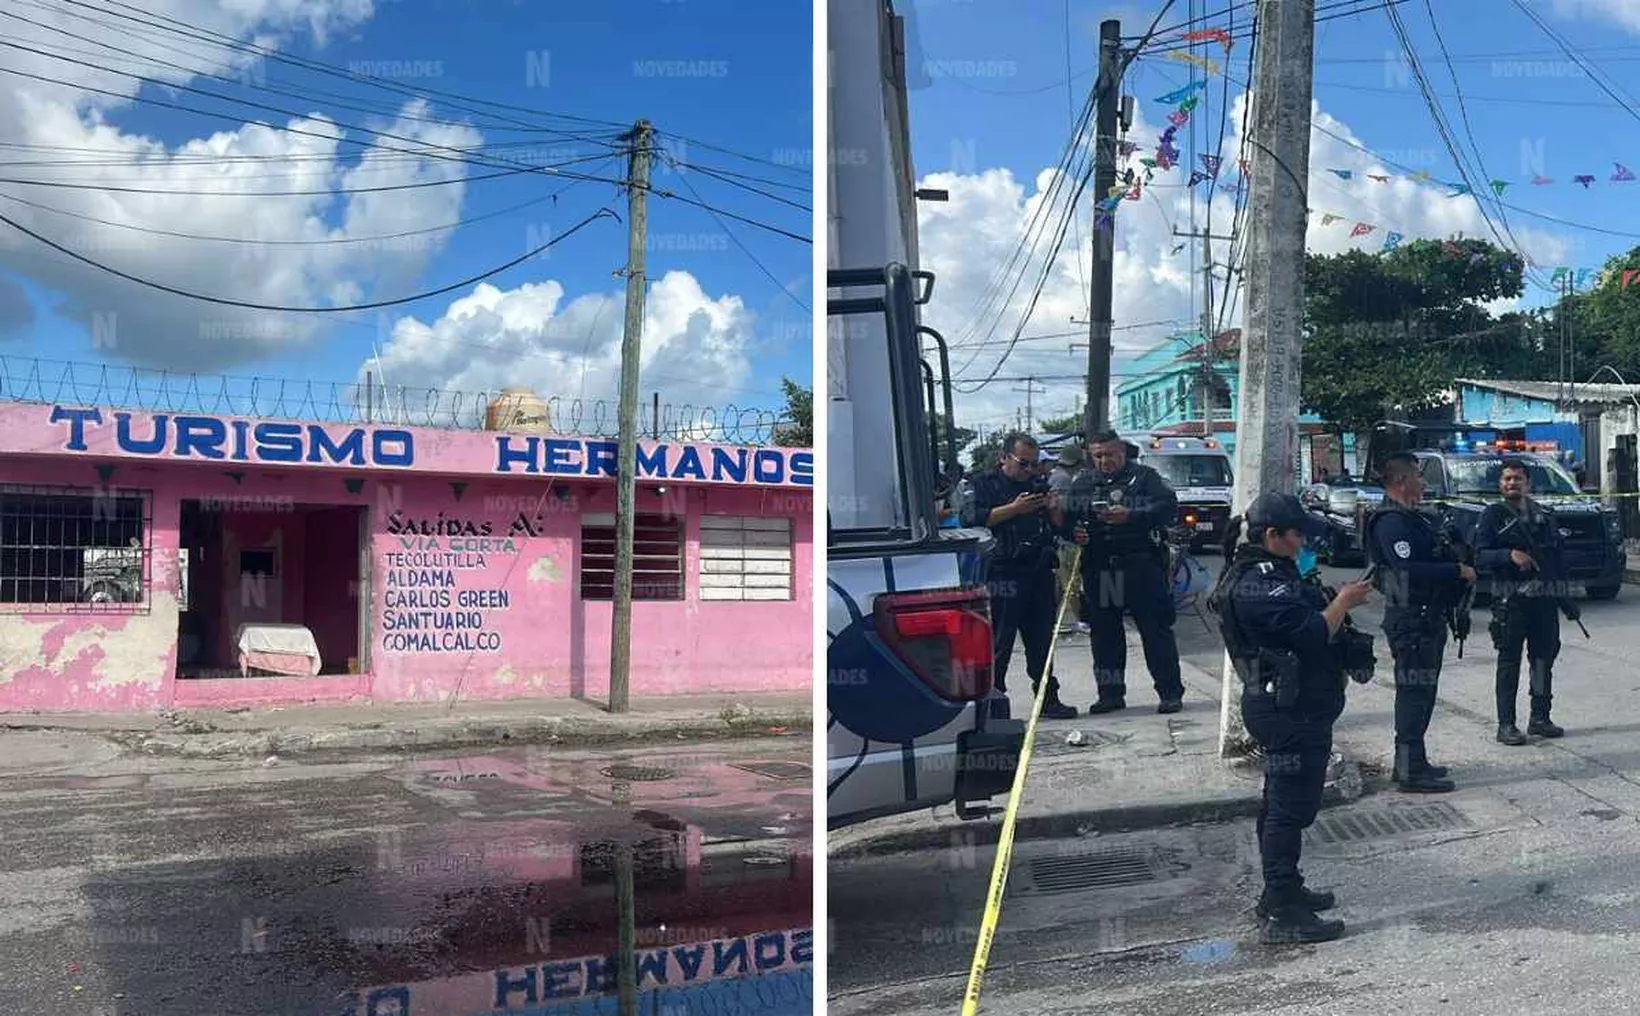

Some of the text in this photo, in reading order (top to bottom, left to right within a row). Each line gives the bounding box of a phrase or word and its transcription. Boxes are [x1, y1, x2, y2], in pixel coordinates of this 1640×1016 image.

[50, 404, 813, 484] TURISMO HERMANOS
[399, 538, 440, 551] VIA
[385, 553, 487, 568] TECOLUTILLA
[387, 570, 455, 587] ALDAMA
[385, 590, 509, 608] CARLOS GREEN
[383, 610, 482, 630] SANTUARIO
[383, 633, 500, 651] COMALCALCO
